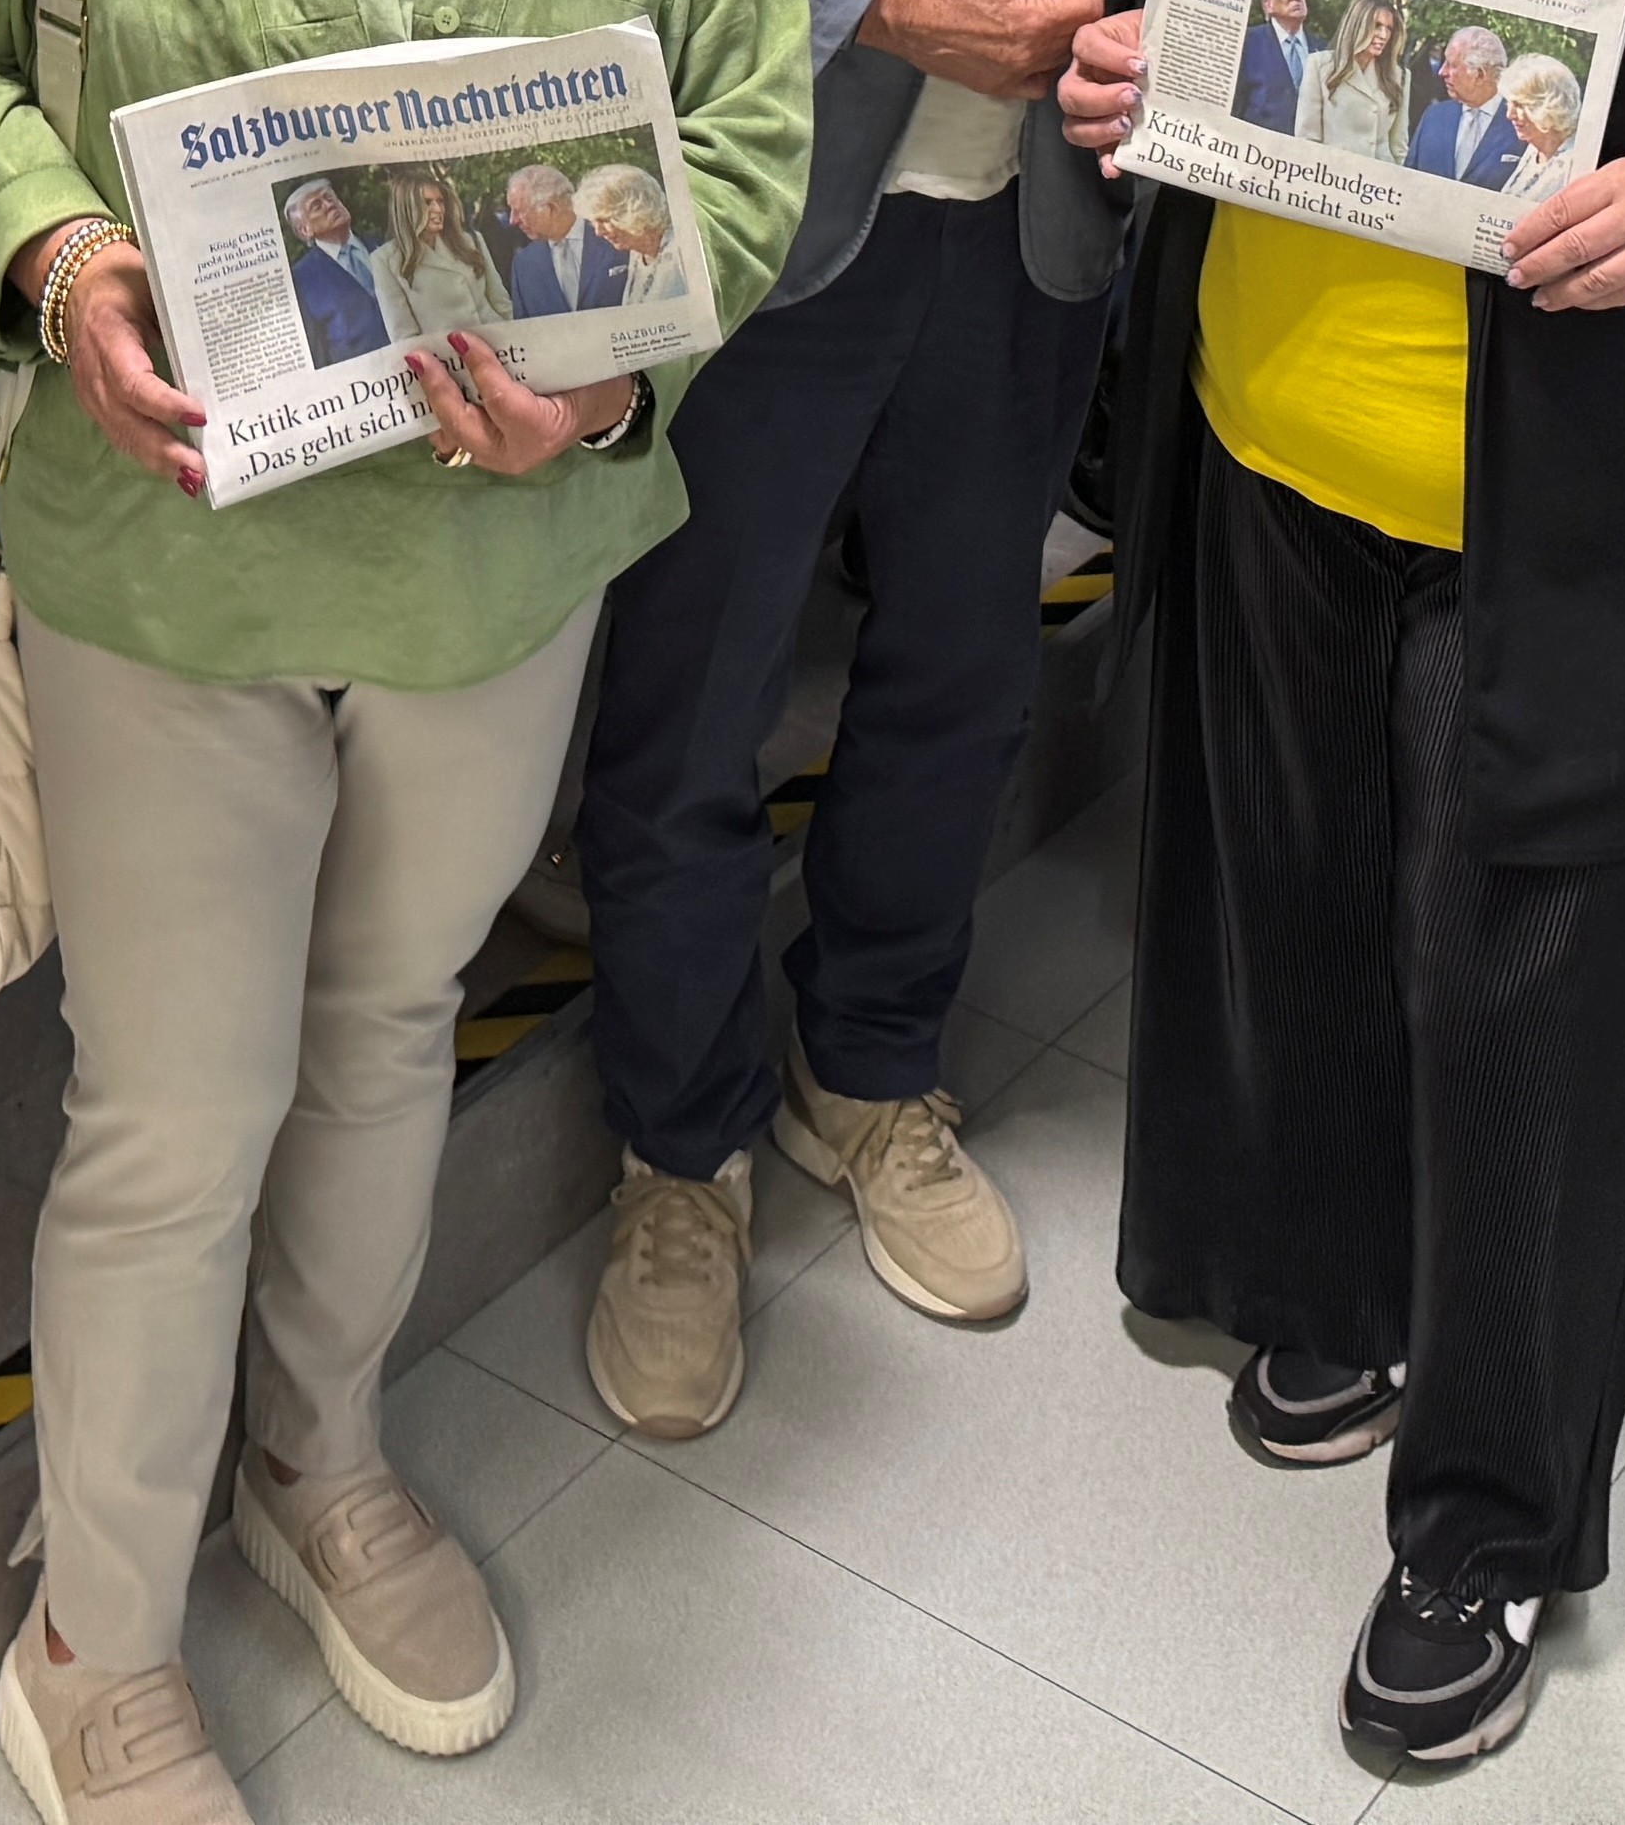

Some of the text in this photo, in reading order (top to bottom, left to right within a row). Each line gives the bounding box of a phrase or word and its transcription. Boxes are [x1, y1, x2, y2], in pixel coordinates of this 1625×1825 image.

[181, 100, 391, 172] Salzburger
[393, 60, 628, 131] Nachrichten
[1146, 109, 1403, 206] Kritik am Doppelbudget:
[1136, 141, 1395, 231] „Das geht sich nicht aus“
[1478, 213, 1515, 231] SALZB
[610, 322, 676, 343] SALZBURG
[227, 403, 302, 447] Kritik
[308, 393, 345, 420] am
[239, 446, 296, 485] „Das
[302, 422, 355, 468] geht
[360, 401, 407, 440] sich
